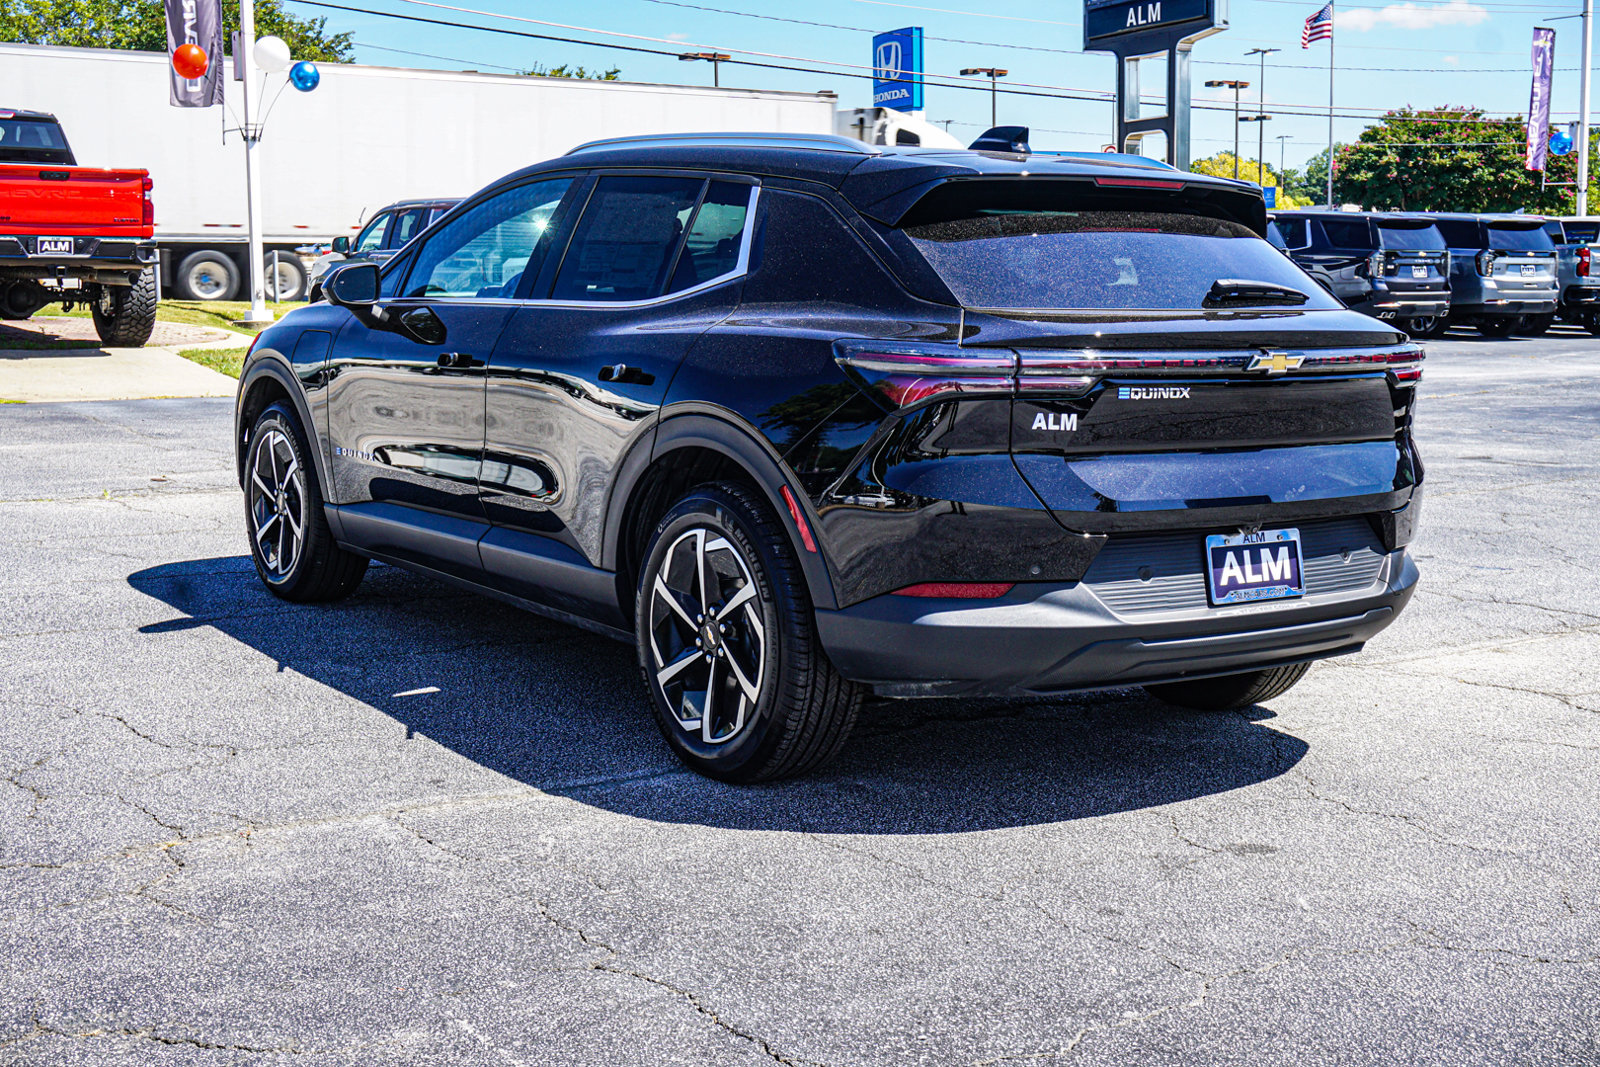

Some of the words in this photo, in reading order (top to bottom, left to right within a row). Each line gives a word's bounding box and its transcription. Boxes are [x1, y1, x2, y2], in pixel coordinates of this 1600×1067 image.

[1126, 2, 1161, 27] ALM
[873, 88, 910, 104] HONDA
[41, 240, 70, 251] ALM
[1118, 387, 1191, 400] EQUINOX
[1031, 412, 1078, 431] ALM
[1243, 532, 1266, 544] ALM
[734, 527, 771, 600] MICHELIN
[1220, 546, 1292, 586] ALM
